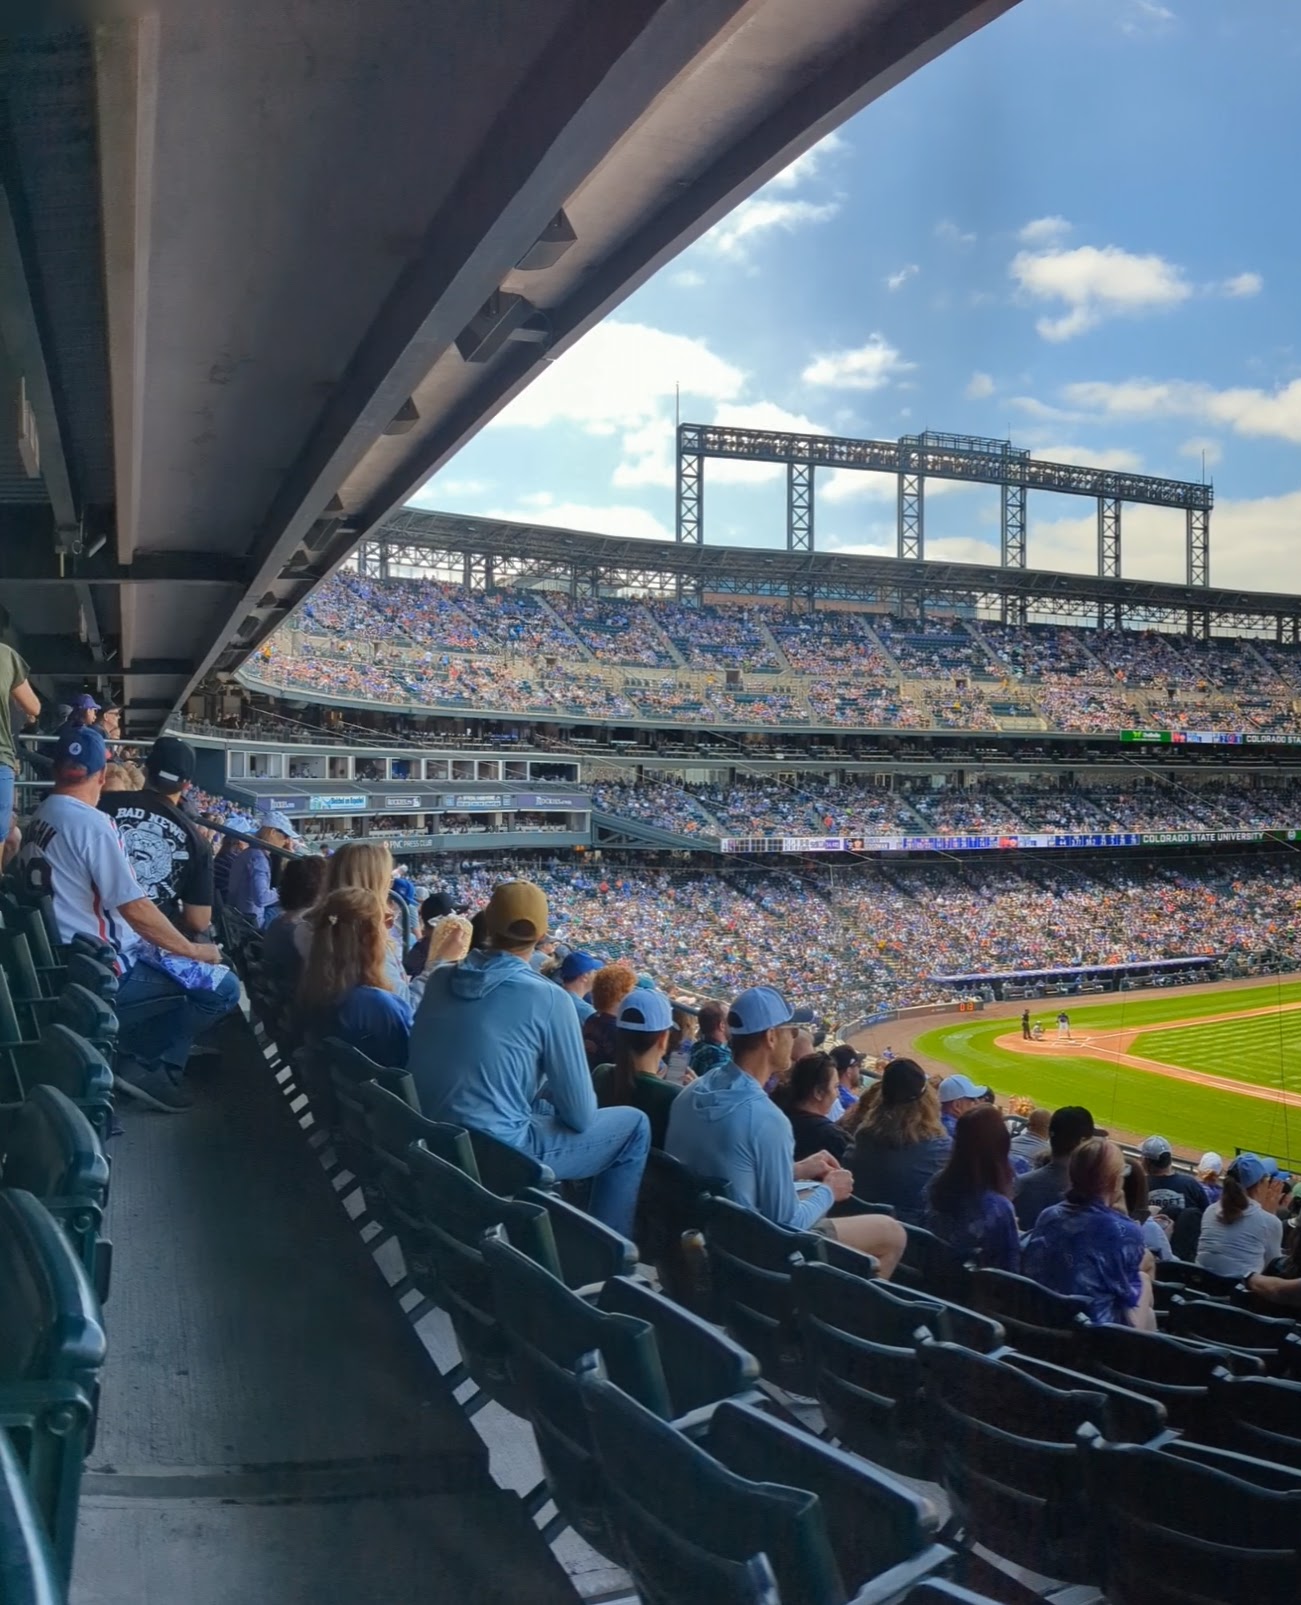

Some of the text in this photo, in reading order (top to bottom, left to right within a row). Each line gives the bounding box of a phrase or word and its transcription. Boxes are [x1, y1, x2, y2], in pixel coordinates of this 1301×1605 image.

[1246, 735, 1287, 745] COLORADO
[115, 807, 188, 843] BAD NEWS
[1143, 834, 1189, 844] COLORADO
[1190, 833, 1216, 843] STATE
[1217, 831, 1264, 842] UNIVERSITY
[389, 839, 432, 849] PNC PRESS CLUB
